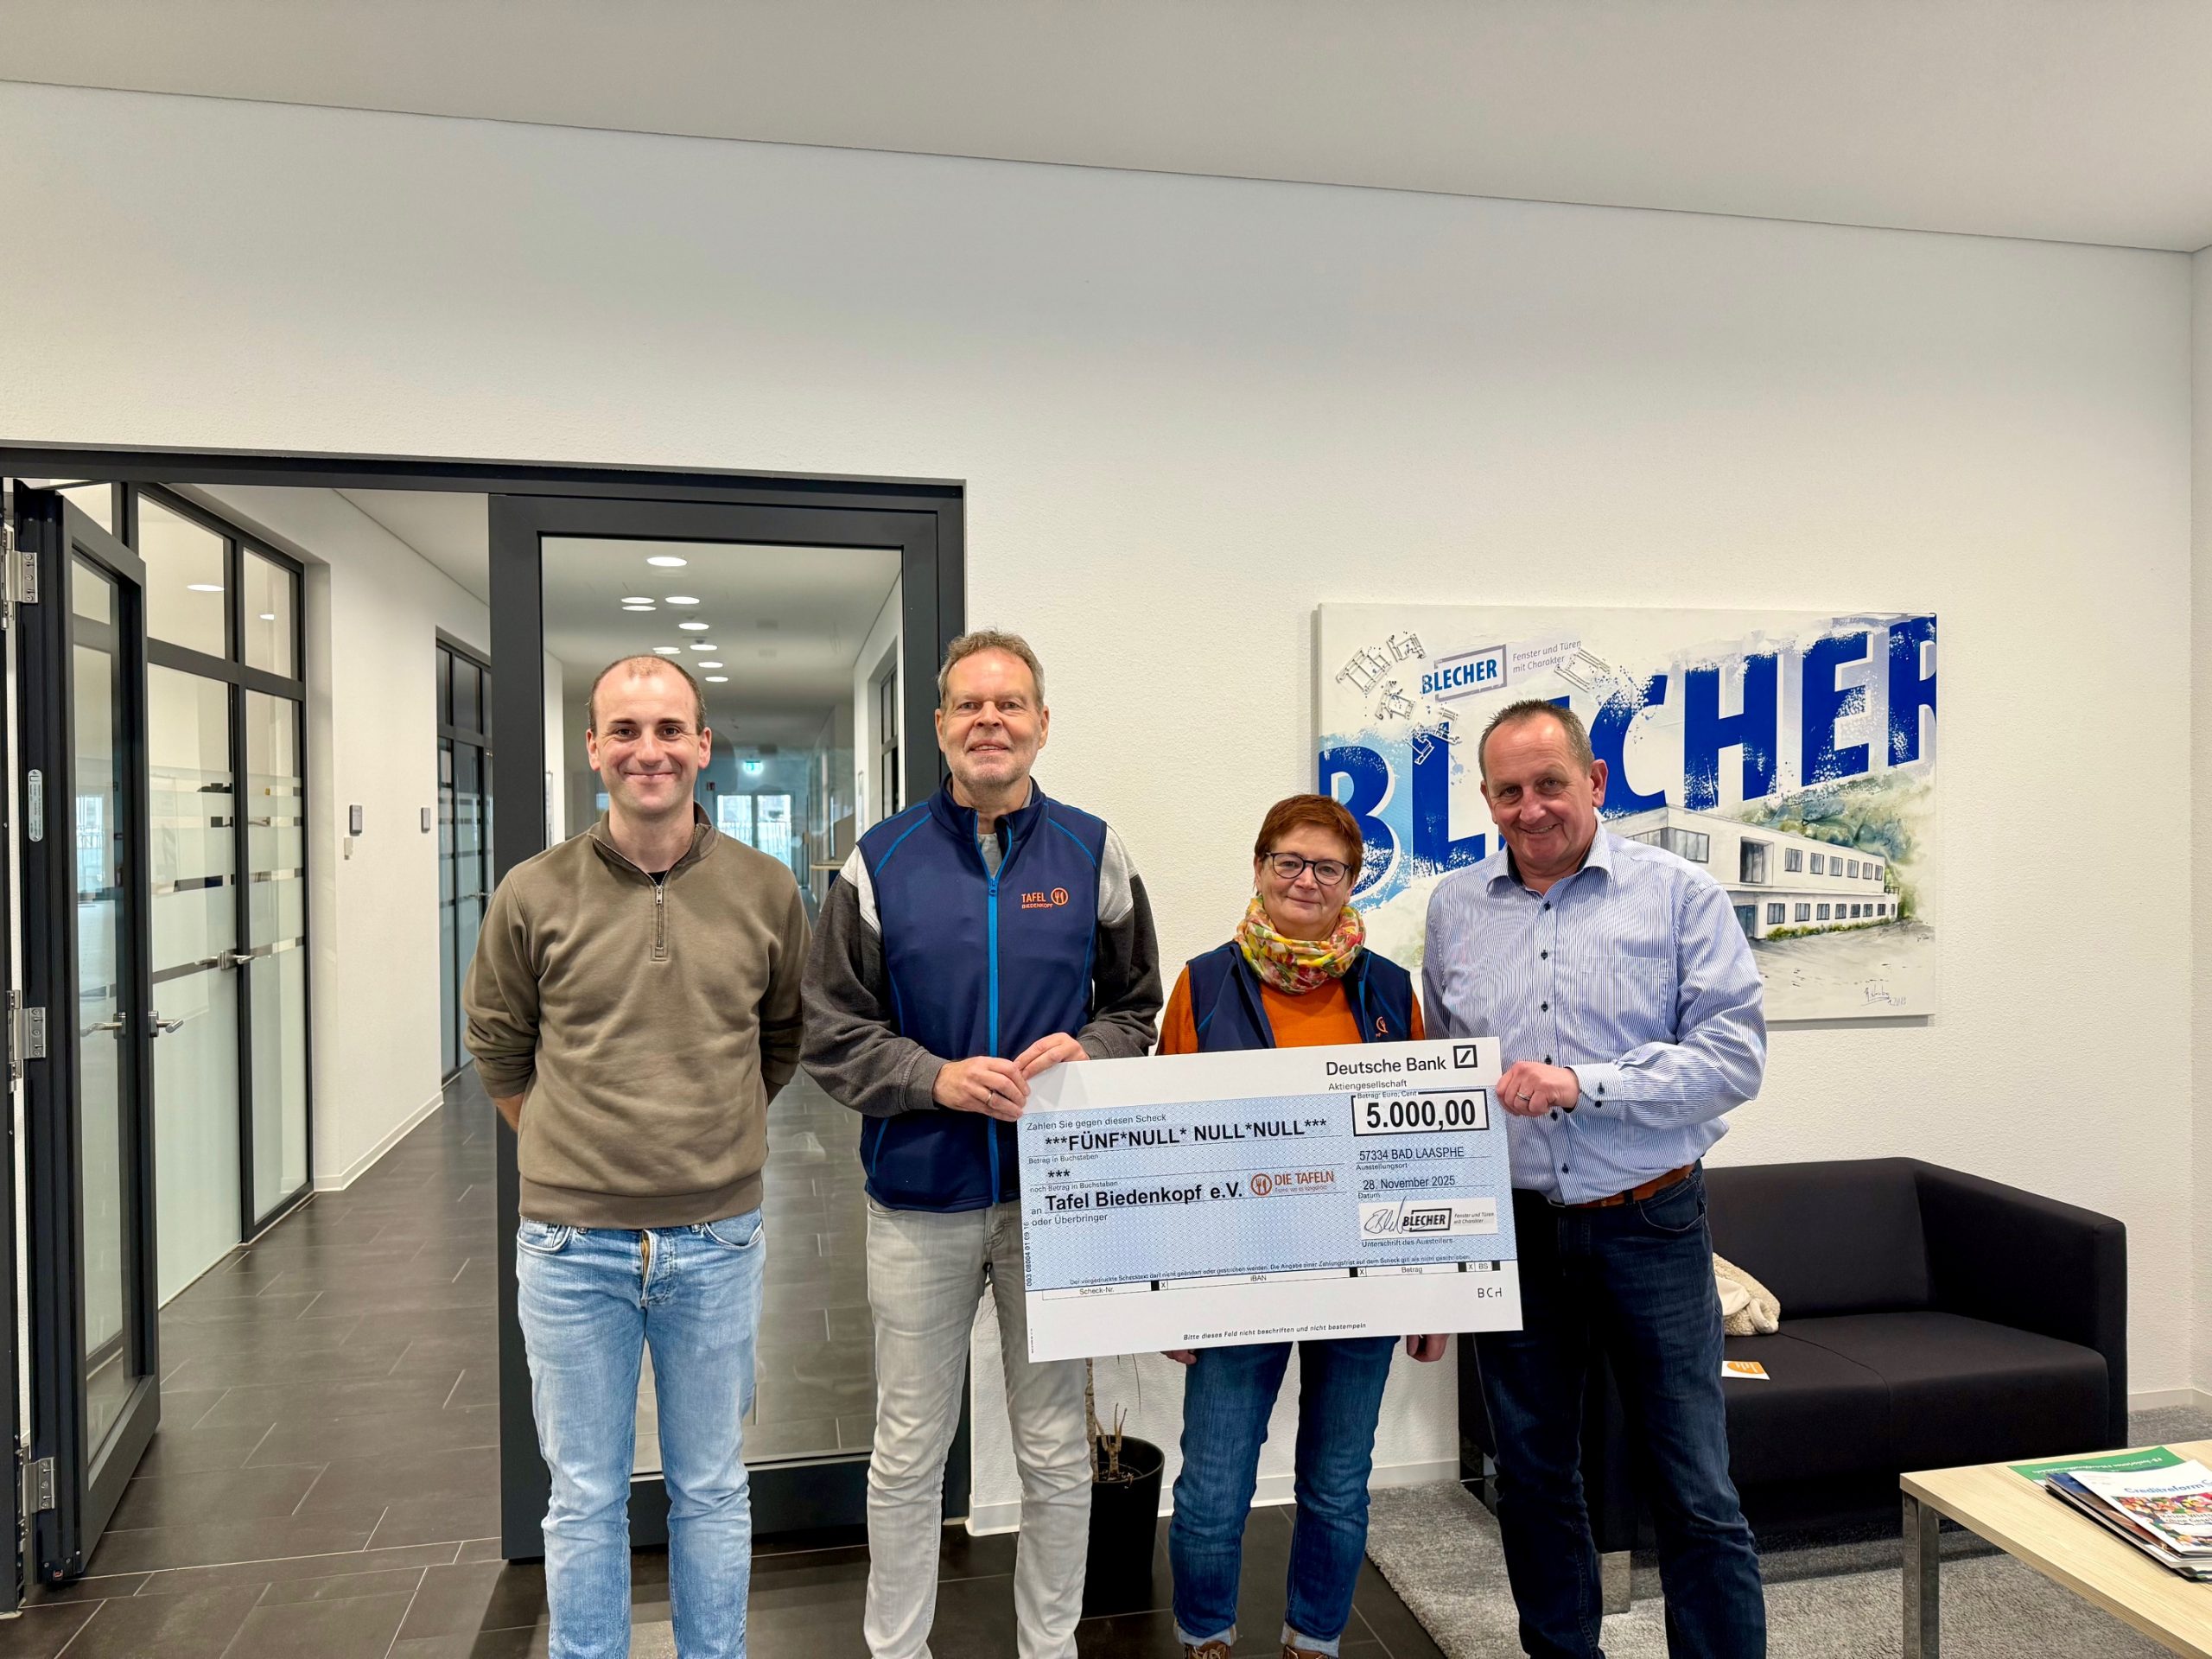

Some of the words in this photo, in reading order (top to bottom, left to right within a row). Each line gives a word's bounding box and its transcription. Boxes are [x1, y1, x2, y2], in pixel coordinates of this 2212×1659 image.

[1512, 651, 1542, 663] Fenster
[1542, 645, 1558, 656] und
[1559, 639, 1582, 652] Türen
[1512, 663, 1526, 674] mit
[1527, 655, 1566, 671] Charakter
[1421, 658, 1498, 695] BLECHER
[1319, 615, 1936, 896] BLCHER
[1021, 892, 1046, 904] TAFEL
[1325, 1058, 1402, 1077] Deutsche
[1406, 1055, 1447, 1072] Bank
[1328, 1079, 1408, 1091] Aktiengesellschaft
[1366, 1098, 1476, 1131] 5.000,00
[1027, 1121, 1057, 1131] Zahlen
[1058, 1119, 1073, 1129] Sie
[1075, 1118, 1103, 1129] gegen
[1104, 1116, 1134, 1126] diesen
[1135, 1113, 1166, 1123] Scheck
[1028, 1156, 1051, 1165] Betrag
[1052, 1154, 1058, 1163] in
[1059, 1153, 1099, 1162] Buchstaben
[1359, 1150, 1389, 1161] 57334
[1391, 1148, 1414, 1160] BAD
[1415, 1146, 1465, 1159] LAASPHE
[1356, 1162, 1408, 1171] Ausstellungsort
[1274, 1173, 1293, 1186] DIE
[1294, 1170, 1335, 1185] TAFELN
[1363, 1179, 1378, 1191] 28.
[1381, 1177, 1429, 1190] November
[1431, 1175, 1456, 1186] 2025
[1030, 1185, 1046, 1193] noch
[1048, 1183, 1070, 1192] Betrag
[1071, 1181, 1078, 1190] in
[1080, 1179, 1118, 1189] Buchstaben
[1031, 1207, 1042, 1216] an
[1045, 1192, 1090, 1211] Tafel
[1096, 1185, 1202, 1208] Biedenkopf
[1210, 1182, 1243, 1199] e.V.
[1032, 1217, 1052, 1226] oder
[1054, 1213, 1108, 1225] Überbringer
[1402, 1214, 1446, 1227] BLECHER
[1362, 1239, 1402, 1248] Unterschrift
[1079, 1286, 1115, 1295] Scheck-Nr.
[1257, 1326, 1294, 1335] beschriften
[1328, 1322, 1366, 1331] bestempeln
[2123, 1483, 2204, 1494] Creditreform
